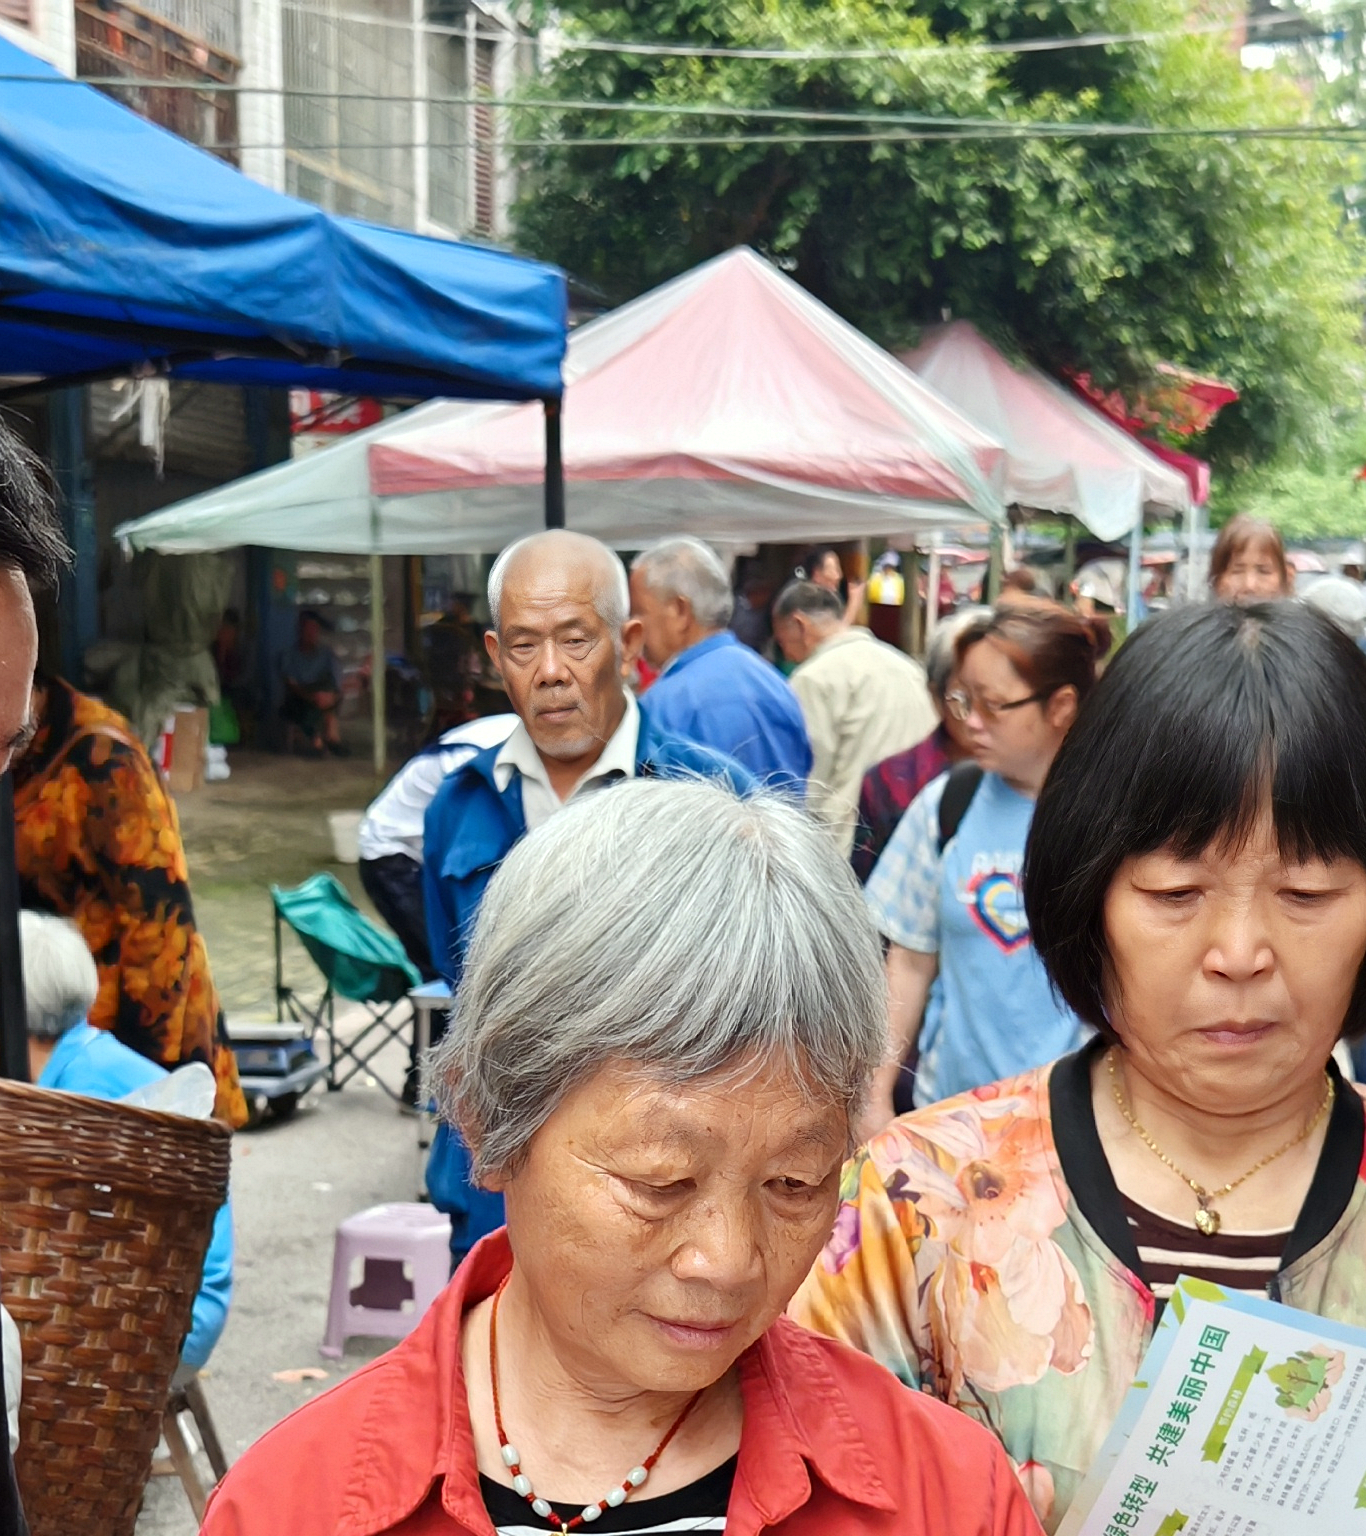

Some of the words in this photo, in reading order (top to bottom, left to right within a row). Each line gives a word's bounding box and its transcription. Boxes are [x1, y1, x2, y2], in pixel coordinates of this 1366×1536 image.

[1143, 1324, 1231, 1468] 共建美丽中国
